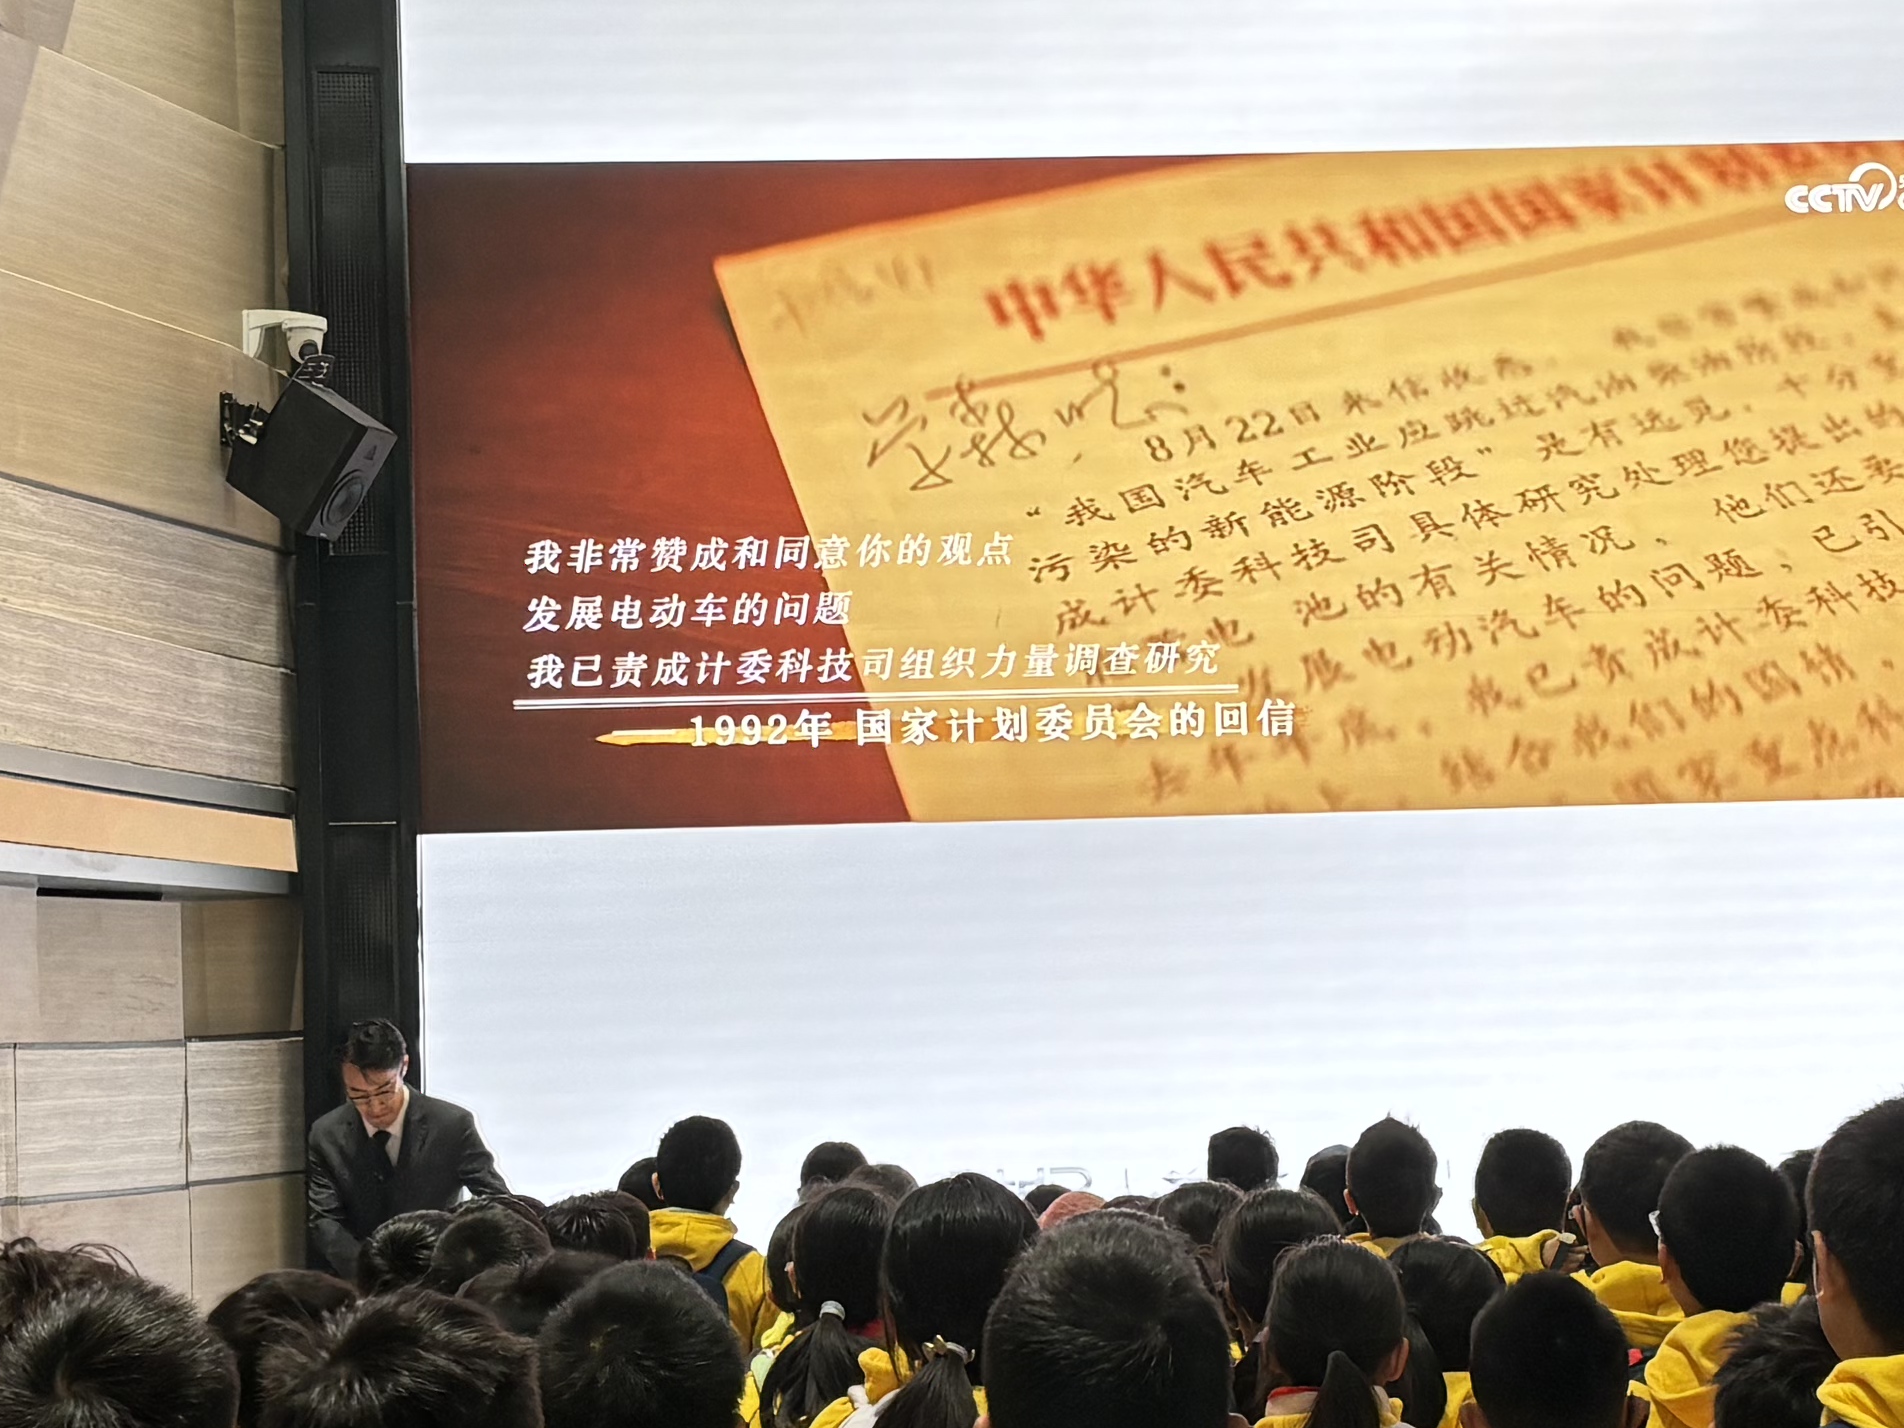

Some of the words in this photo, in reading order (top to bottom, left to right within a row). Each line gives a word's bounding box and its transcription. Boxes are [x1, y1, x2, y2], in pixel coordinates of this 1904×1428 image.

[1784, 181, 1886, 214] CCTV
[523, 529, 1015, 575] 我非常赞成和同意你的观点
[521, 588, 854, 633] 发展电动车的问题
[526, 639, 1222, 690] 我已责成计委科技司组织力量调查研究
[855, 700, 1296, 745] 国家计划委员会的回信
